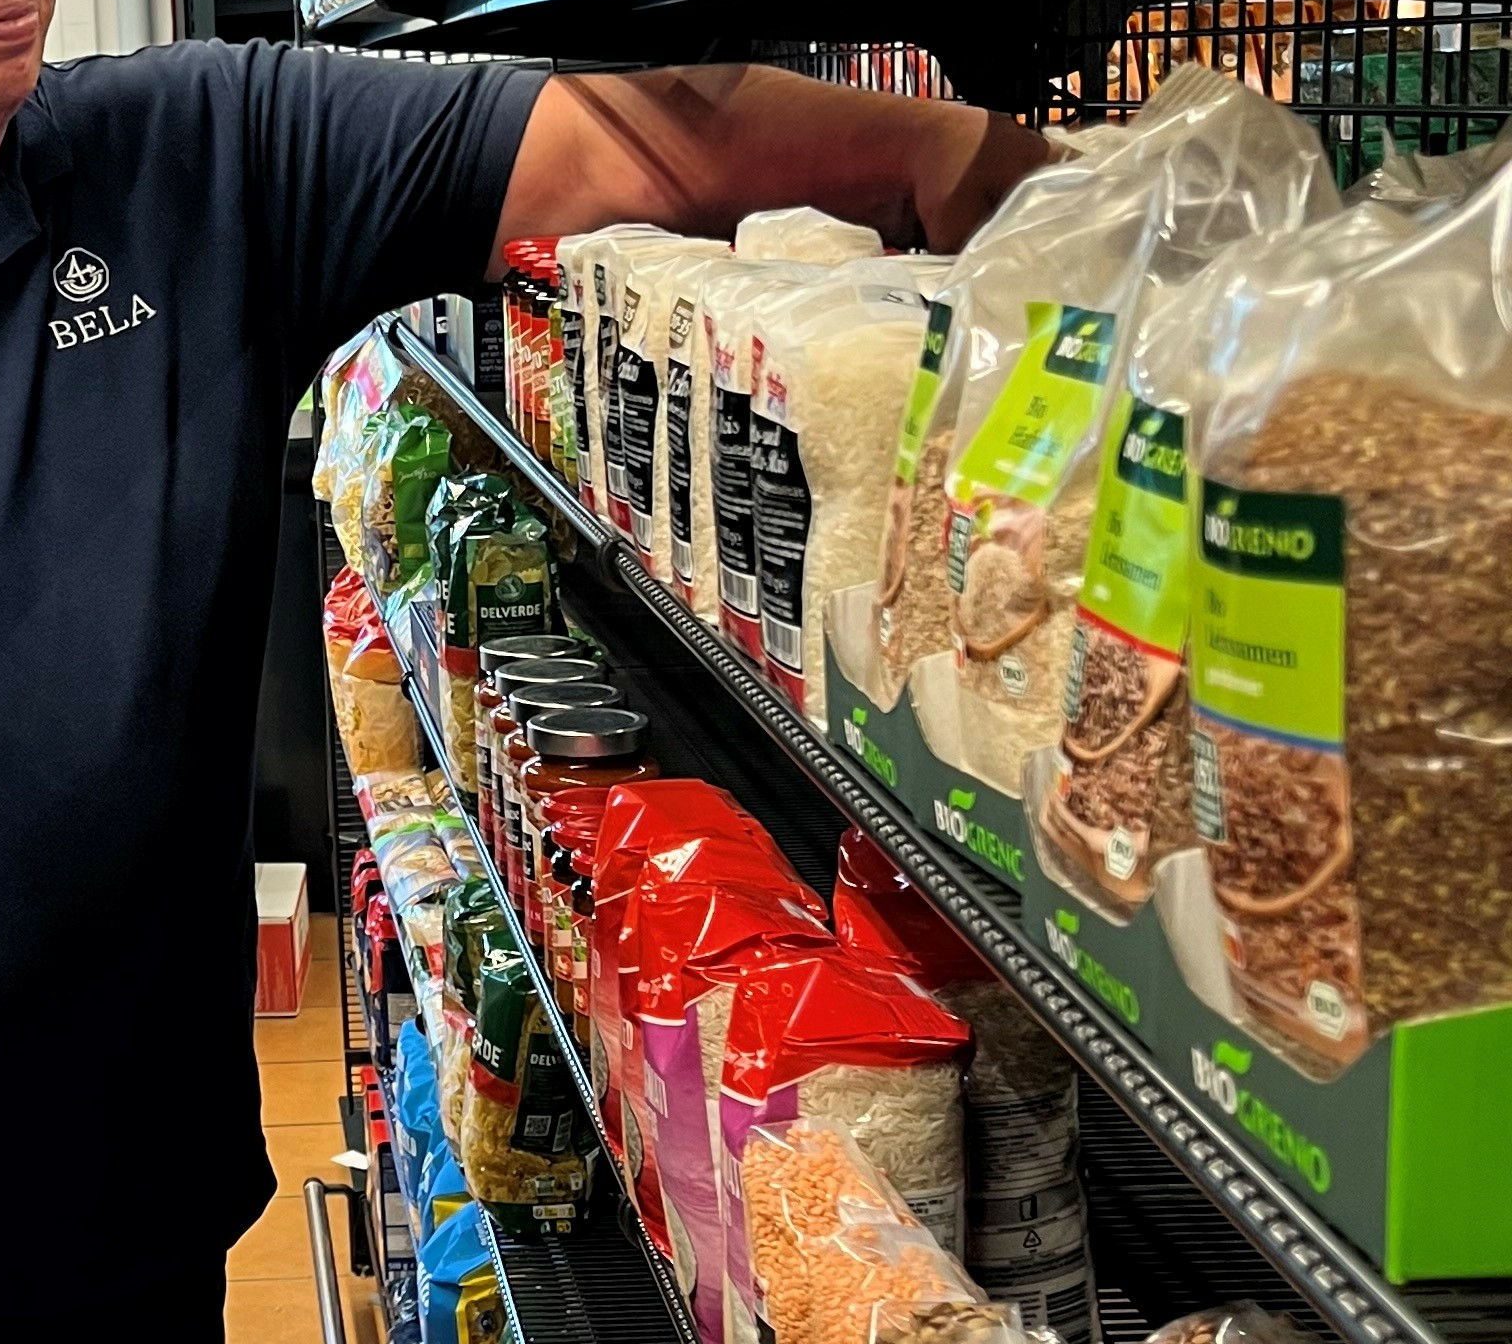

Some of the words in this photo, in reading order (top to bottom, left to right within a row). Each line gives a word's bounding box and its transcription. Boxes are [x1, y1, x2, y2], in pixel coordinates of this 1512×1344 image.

[48, 294, 157, 349] BELA
[480, 604, 541, 620] DELVERDE
[1190, 1046, 1332, 1194] BIOGRENO
